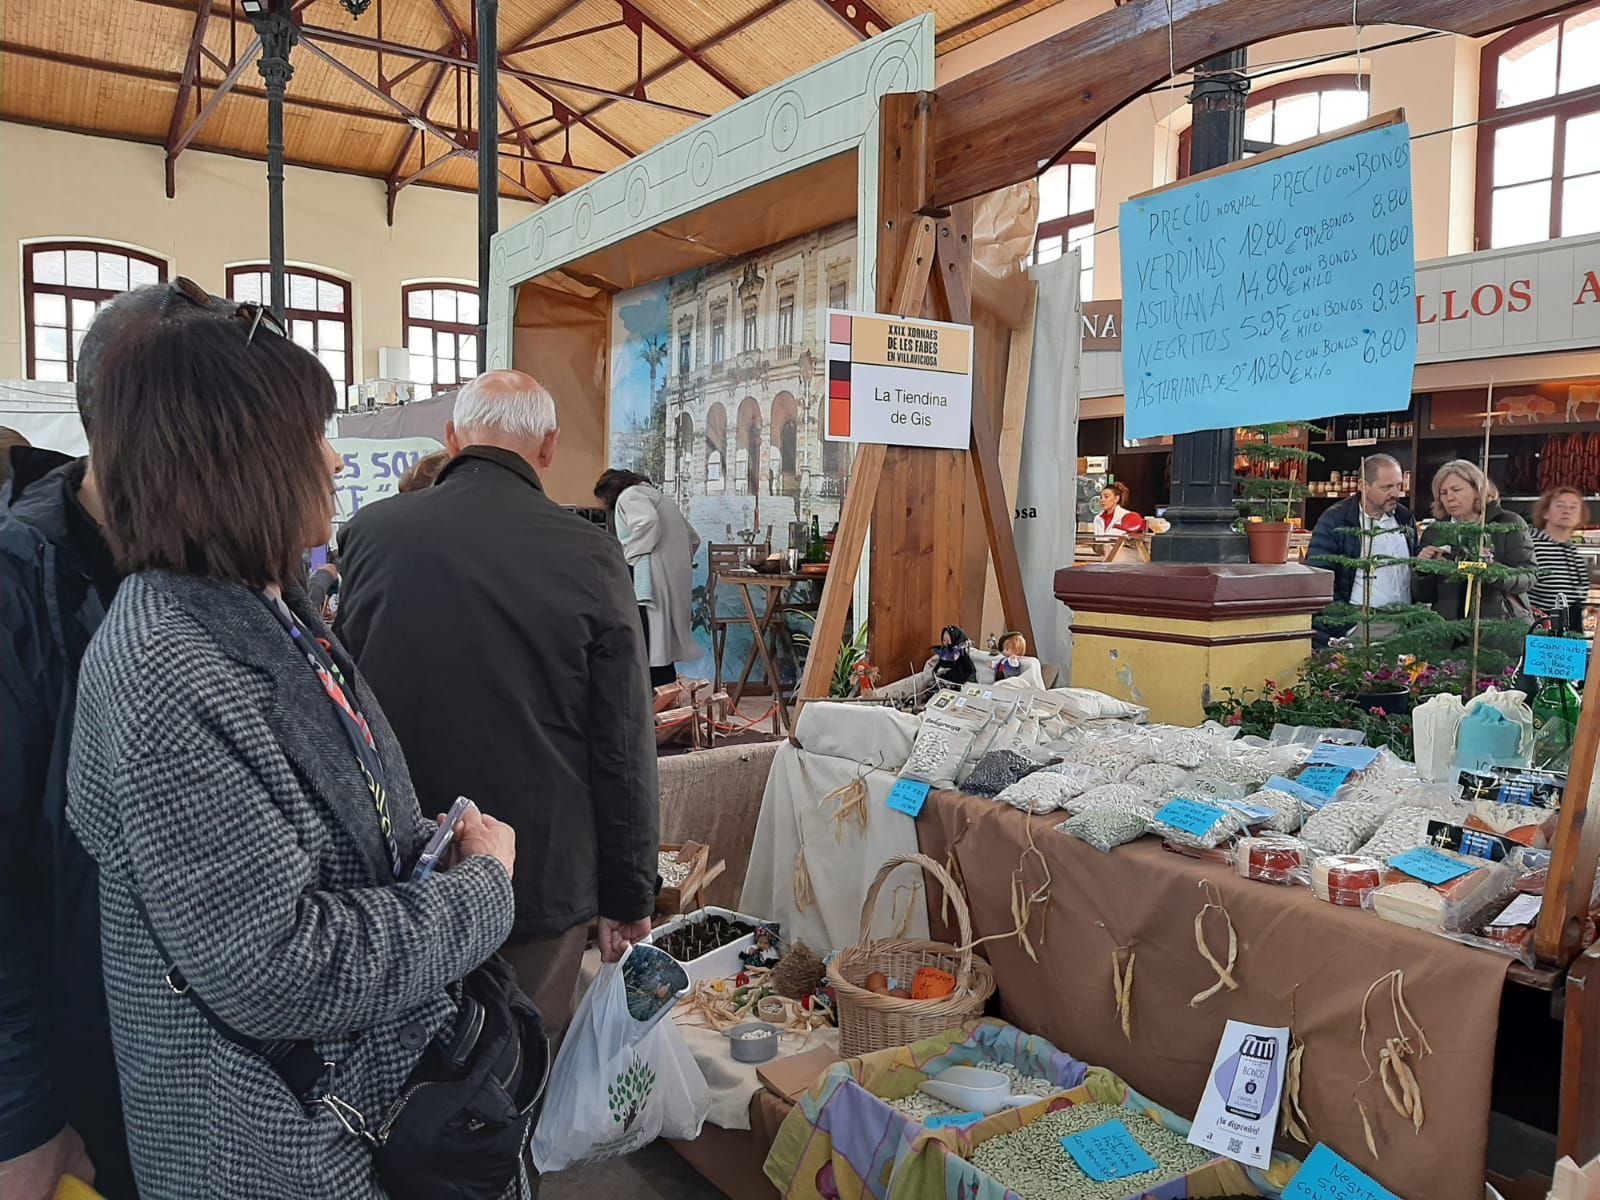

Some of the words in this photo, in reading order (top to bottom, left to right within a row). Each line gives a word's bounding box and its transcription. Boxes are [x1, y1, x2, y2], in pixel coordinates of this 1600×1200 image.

[1336, 165, 1355, 178] CON
[1345, 142, 1409, 199] BONOS
[1271, 164, 1333, 207] PRECIO
[1217, 194, 1261, 217] NORMAL
[1149, 192, 1210, 245] PRECIO
[1137, 237, 1226, 294] VERDINAS
[1294, 225, 1317, 239] CON
[1321, 212, 1354, 231] BONOS
[1371, 186, 1408, 219] 8,80
[1292, 263, 1312, 277] CON
[1318, 248, 1358, 270] BONOS
[1369, 225, 1409, 257] 10,80
[1303, 270, 1332, 293] KILO
[1415, 279, 1533, 325] LLOS
[888, 324, 906, 337] XXIX
[908, 326, 938, 341] XORNAES
[1138, 327, 1231, 369] NEGRITOS
[1292, 307, 1320, 323] CON
[1323, 297, 1363, 317] BONOS
[888, 336, 898, 350] DE
[900, 338, 913, 352] LES
[915, 340, 938, 355] FABES
[887, 351, 896, 362] EN
[897, 352, 938, 367] VILLAVICIOSA
[1135, 373, 1212, 410] ASTURIANA
[1294, 347, 1318, 361] CON
[1322, 336, 1359, 358] BONOS
[1363, 326, 1406, 363] 6,80
[875, 386, 891, 403] La
[894, 388, 948, 408] Tiendina
[890, 410, 907, 425] de
[911, 411, 932, 427] Gis
[1242, 1065, 1266, 1080] BONOS
